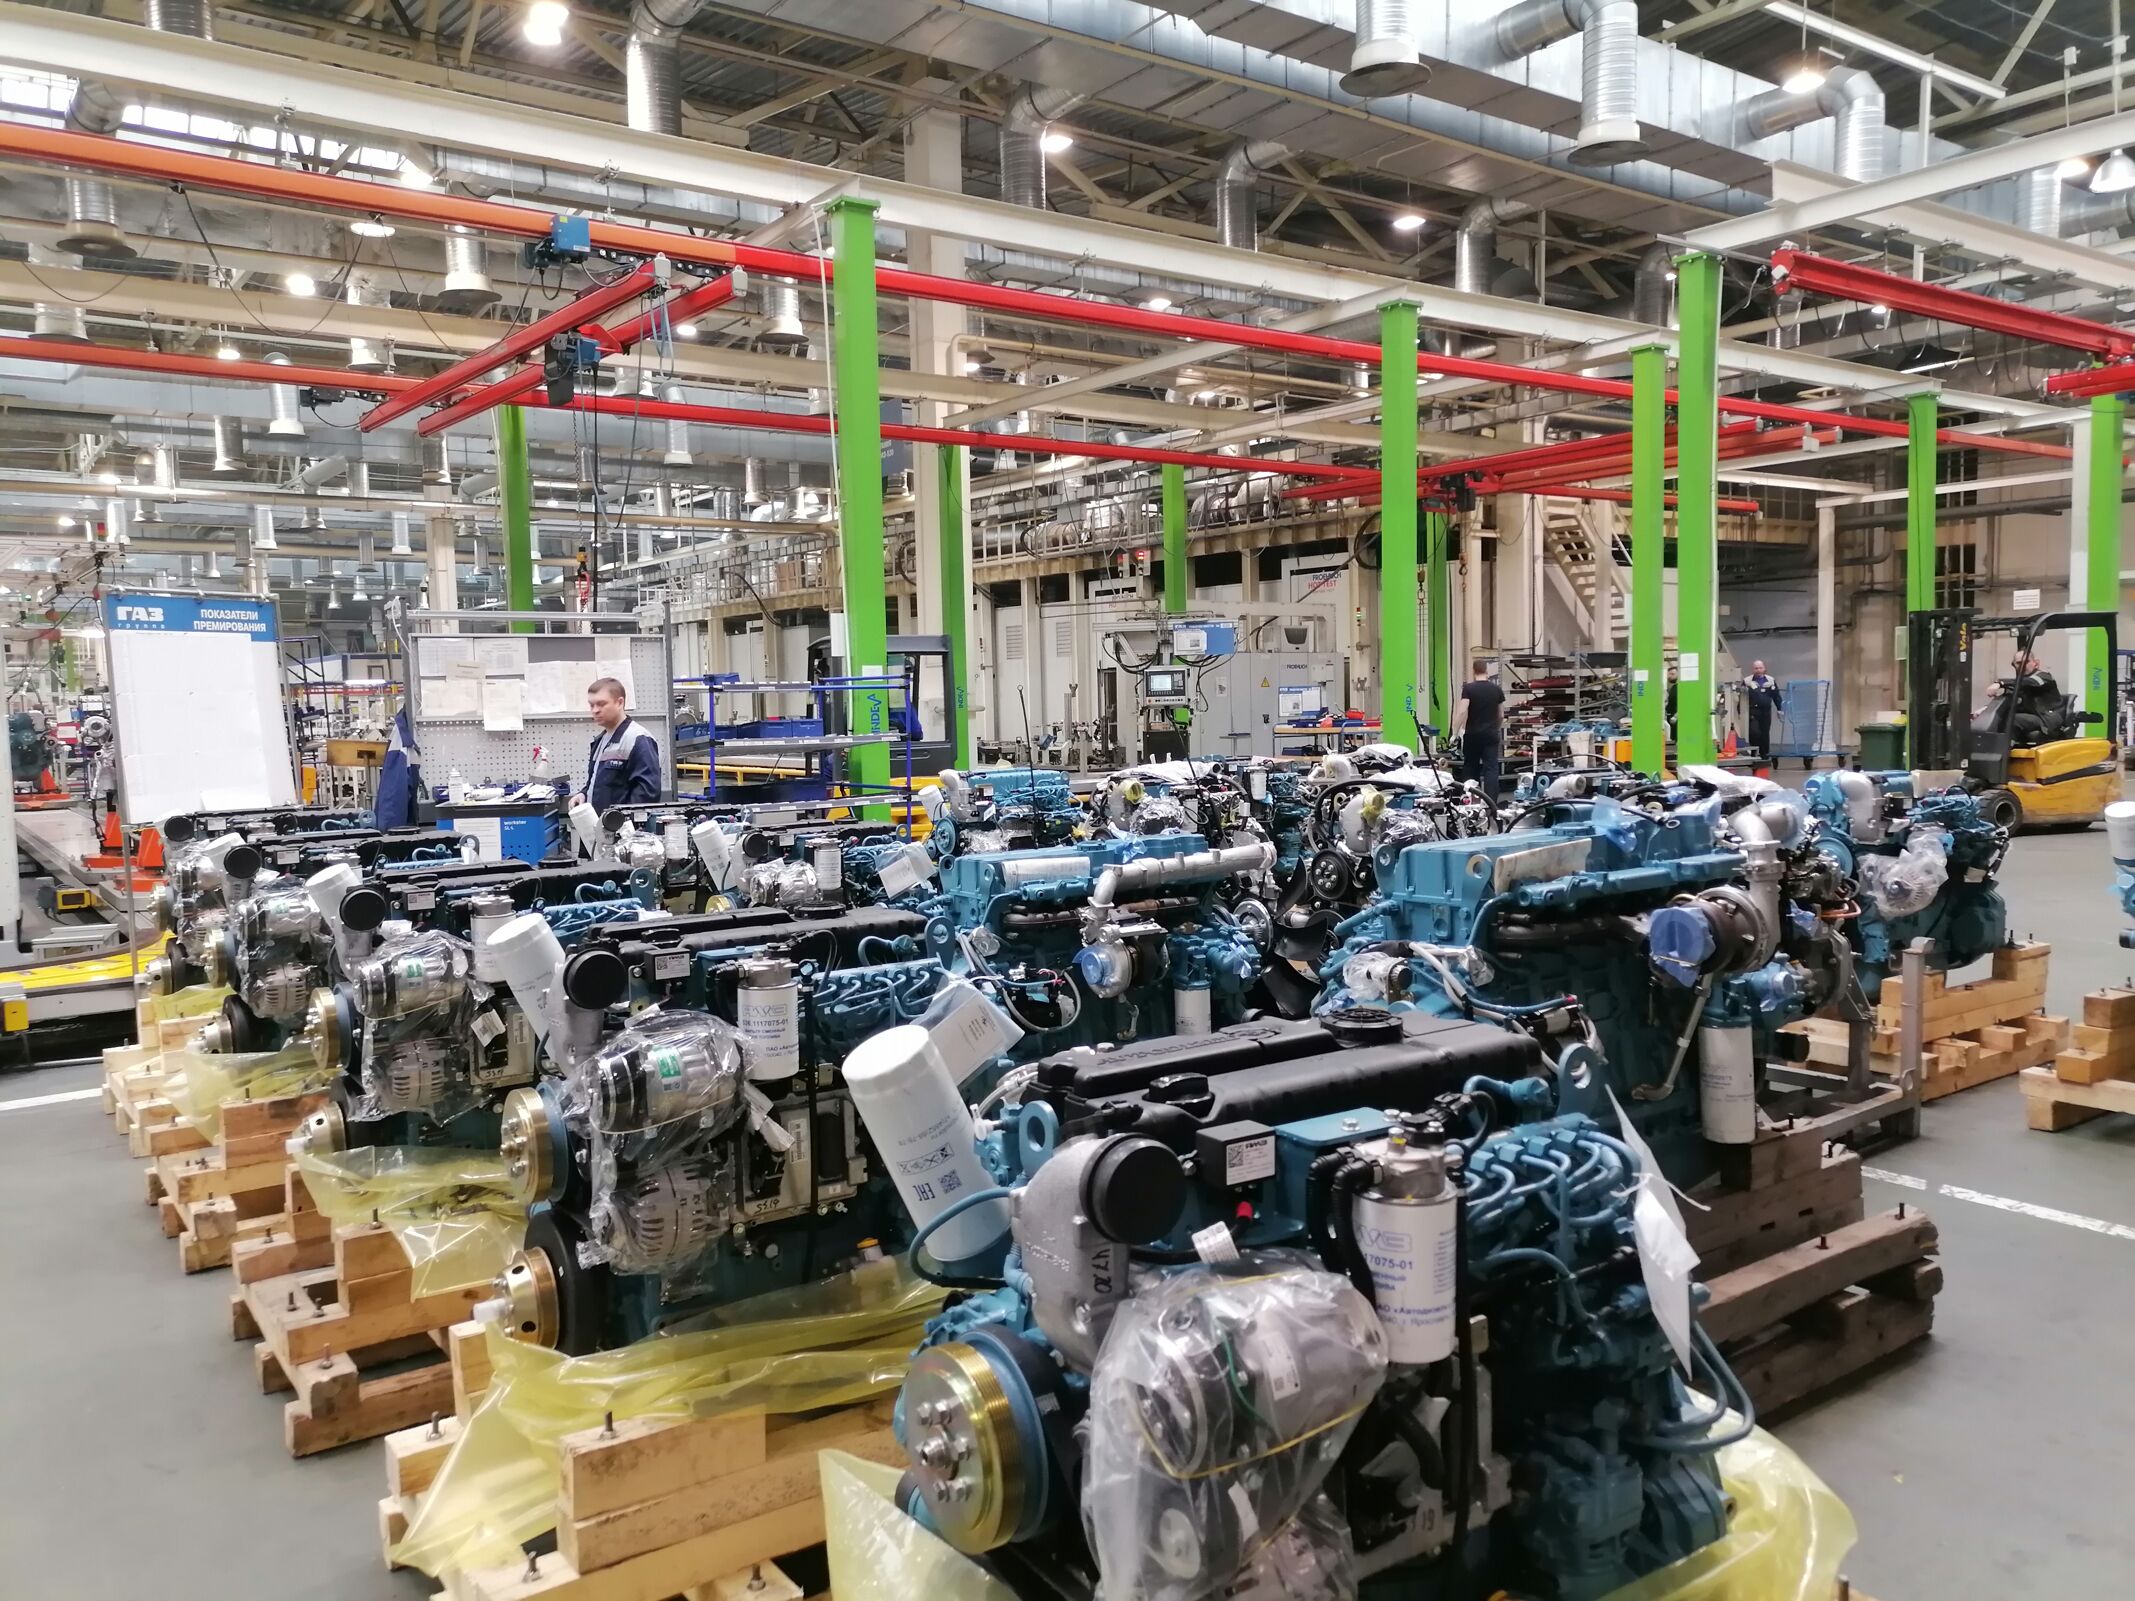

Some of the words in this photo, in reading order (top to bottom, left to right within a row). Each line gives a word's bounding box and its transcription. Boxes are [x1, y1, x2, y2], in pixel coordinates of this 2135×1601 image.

[117, 606, 164, 622] ГАЗ
[200, 608, 259, 621] ПОКАЗАТЕЛИ
[117, 622, 166, 630] группа
[193, 620, 267, 633] ПРЕМИРОВАНИЯ
[1364, 1253, 1414, 1270] 17075-01
